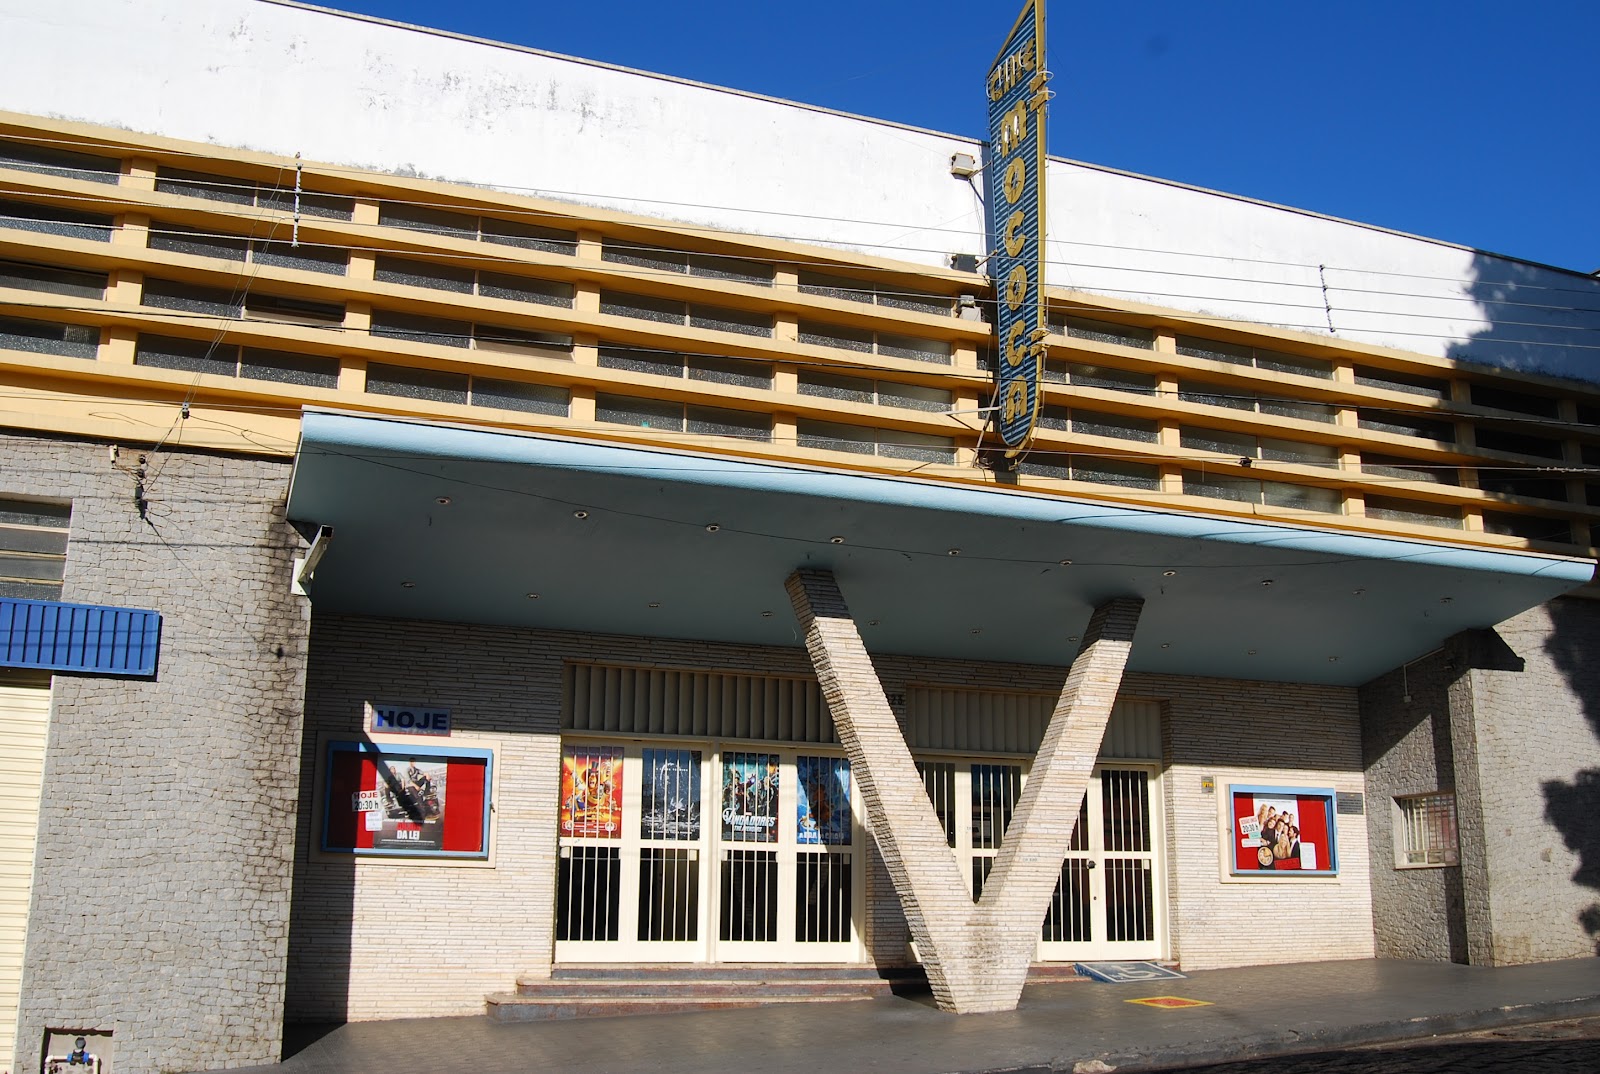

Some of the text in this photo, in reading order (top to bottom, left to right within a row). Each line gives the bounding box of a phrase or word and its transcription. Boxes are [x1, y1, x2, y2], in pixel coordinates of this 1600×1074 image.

[376, 710, 447, 730] HOJE
[353, 792, 378, 800] HOJE
[354, 800, 373, 810] 20:30
[396, 830, 420, 840] DA LEI
